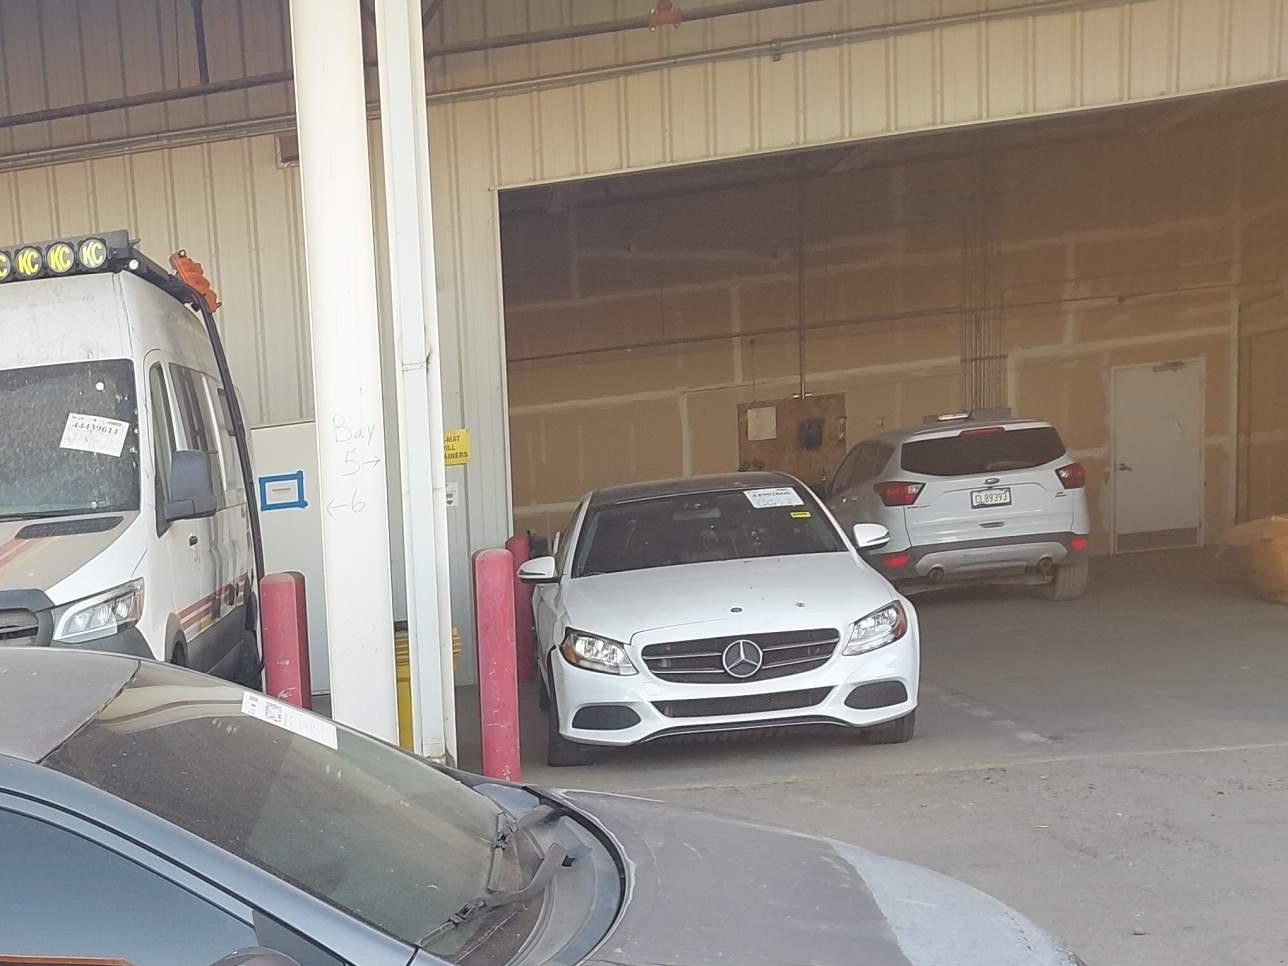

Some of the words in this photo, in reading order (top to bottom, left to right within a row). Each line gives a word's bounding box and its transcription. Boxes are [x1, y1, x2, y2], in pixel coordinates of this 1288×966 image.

[18, 250, 39, 275] KC
[49, 245, 71, 271] KC
[82, 241, 104, 267] KC
[333, 414, 375, 446] Bay
[339, 448, 360, 477] 5
[351, 487, 367, 513] 6
